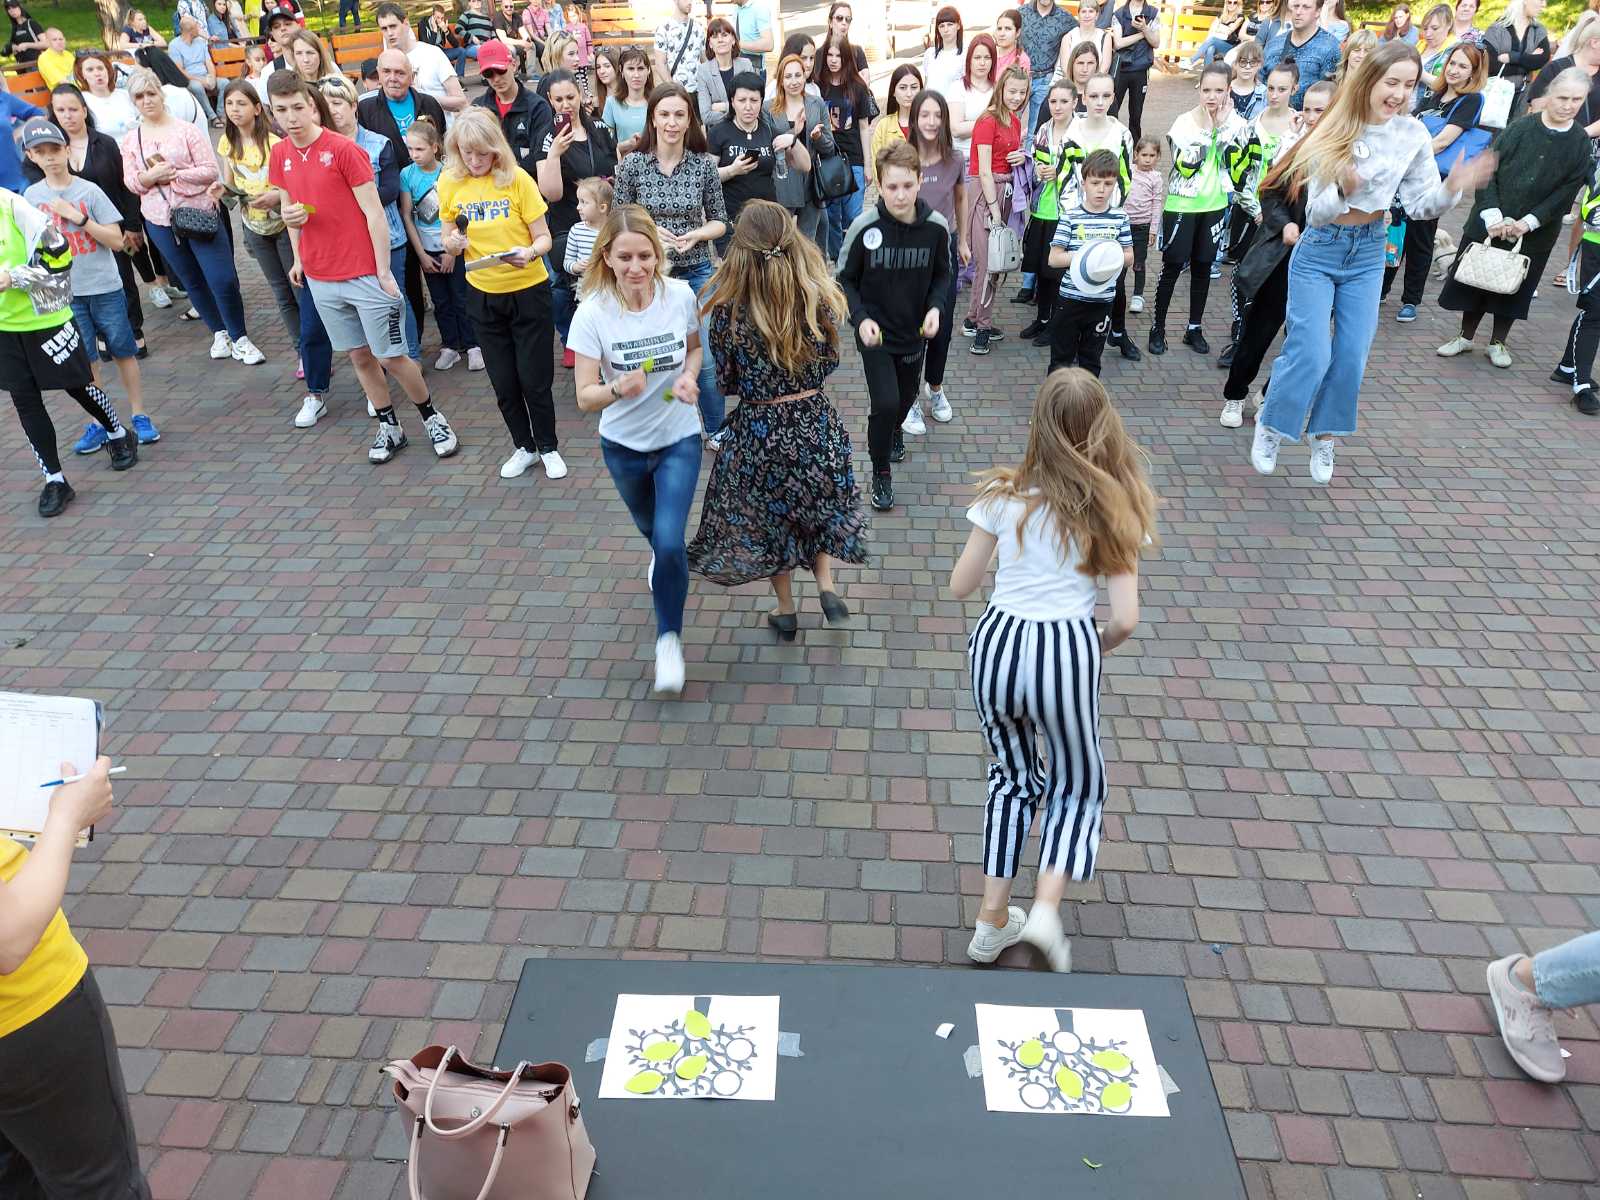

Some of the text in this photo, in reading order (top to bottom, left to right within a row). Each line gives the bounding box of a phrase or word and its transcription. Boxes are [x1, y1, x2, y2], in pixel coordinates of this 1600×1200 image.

[32, 128, 52, 136] FILA
[870, 247, 931, 269] PUMA
[621, 335, 666, 349] CHARMING
[632, 343, 681, 358] GORGEOUS
